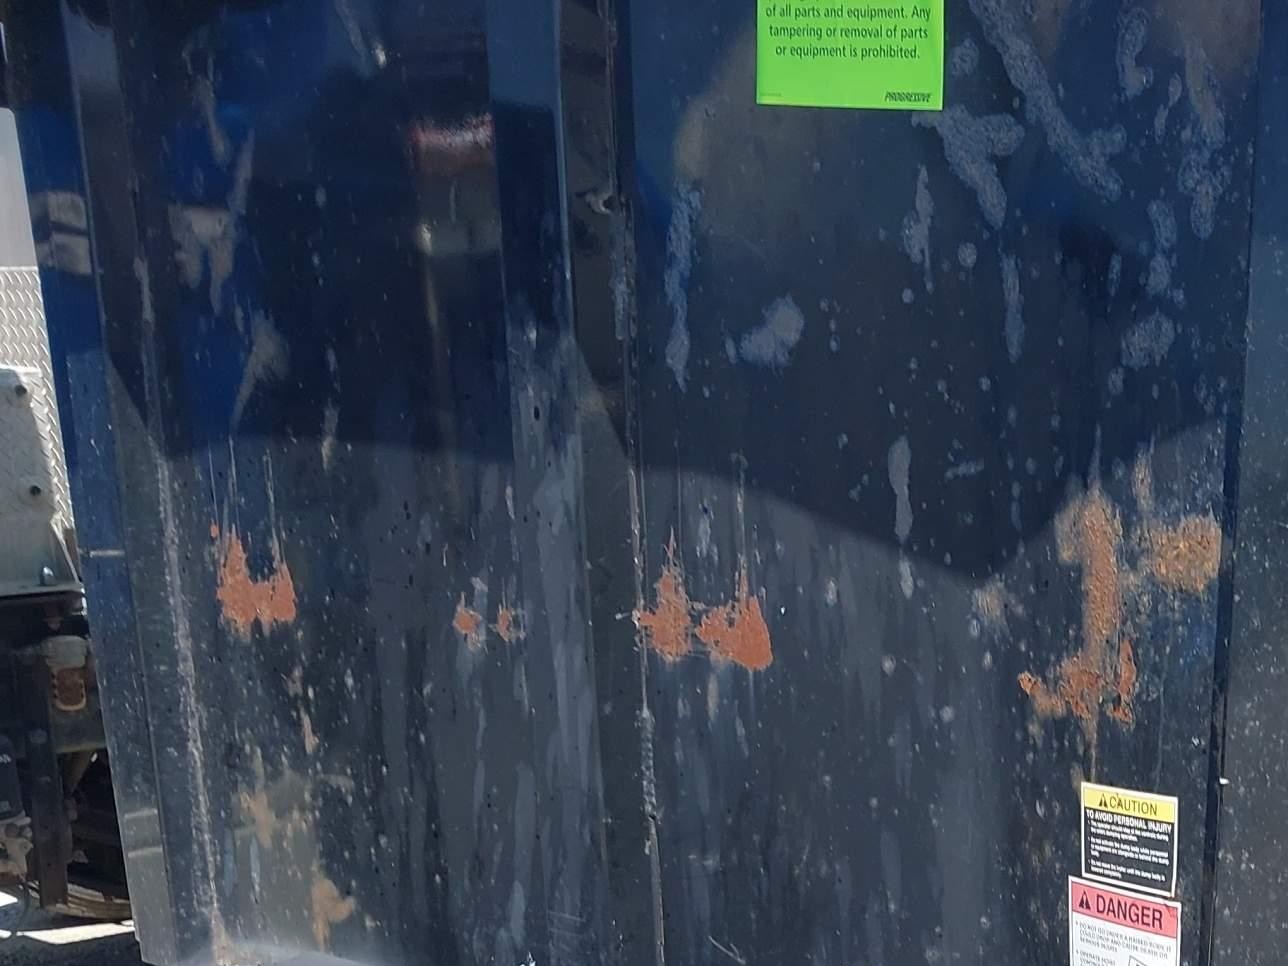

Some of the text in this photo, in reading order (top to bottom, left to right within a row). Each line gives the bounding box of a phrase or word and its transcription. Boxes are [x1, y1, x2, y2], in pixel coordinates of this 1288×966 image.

[765, 5, 931, 22] of all parts and equipment. Any
[769, 25, 928, 42] tampering or removal of parts
[775, 45, 920, 60] or equipment is prohibited.
[1109, 795, 1158, 817] CAUTION
[1086, 809, 1093, 819] TO
[1094, 811, 1113, 822] AVOID
[1096, 893, 1163, 931] DANGER
